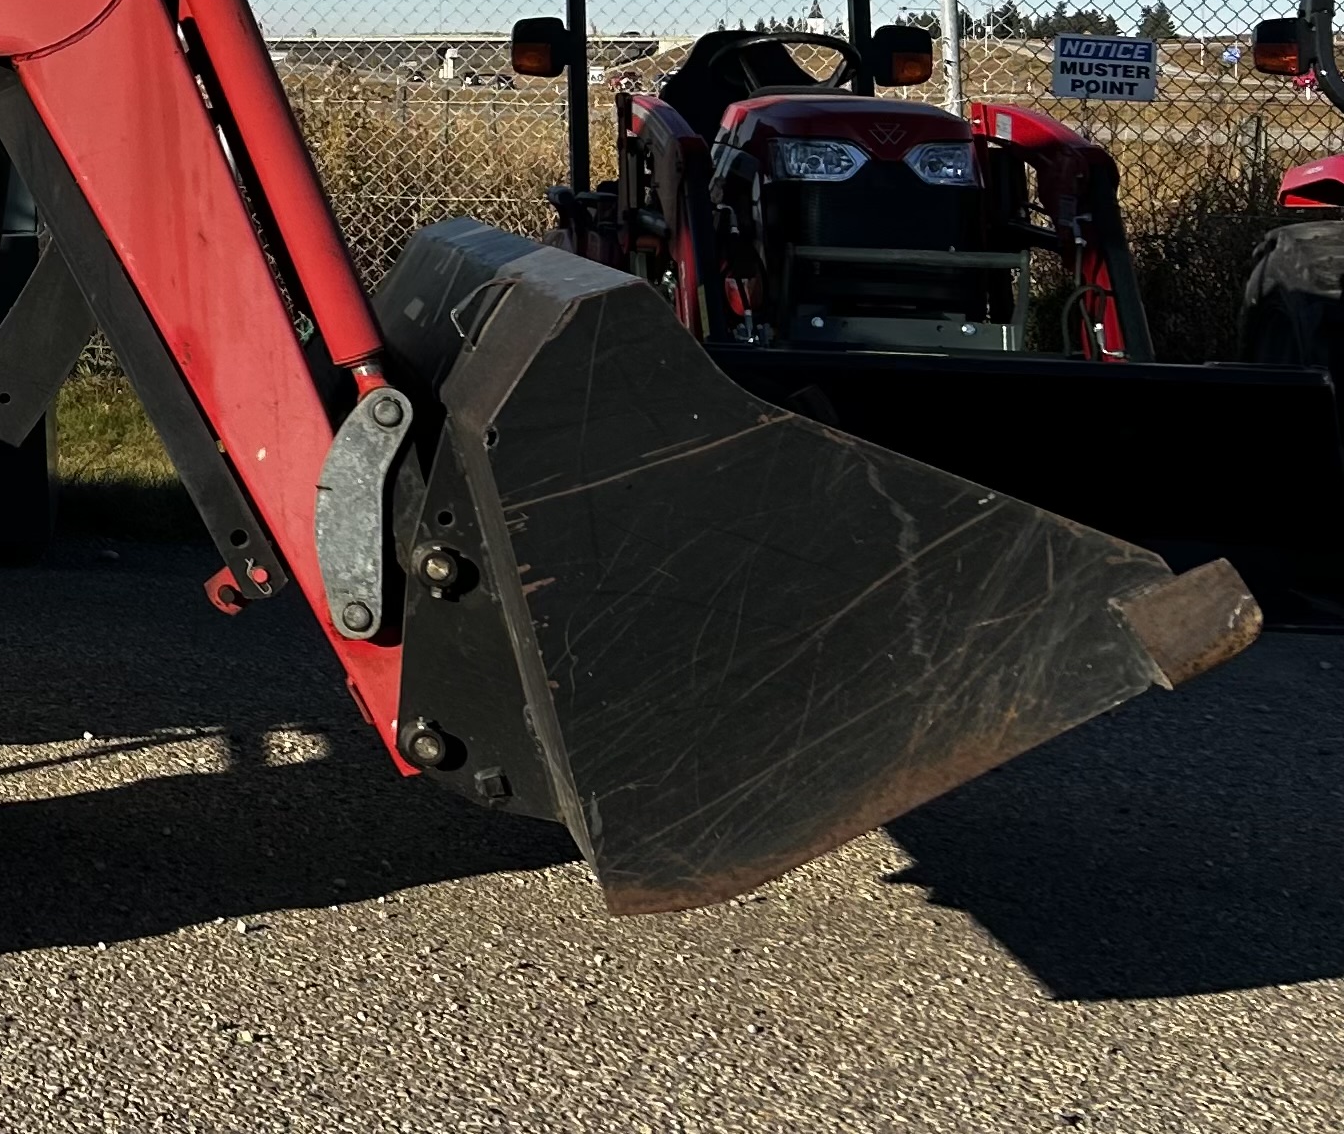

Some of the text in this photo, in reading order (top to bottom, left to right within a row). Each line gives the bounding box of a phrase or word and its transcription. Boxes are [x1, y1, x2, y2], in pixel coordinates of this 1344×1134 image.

[1062, 40, 1149, 60] NOTICE
[1059, 60, 1151, 80] MUSTER
[1070, 78, 1139, 96] POINT
